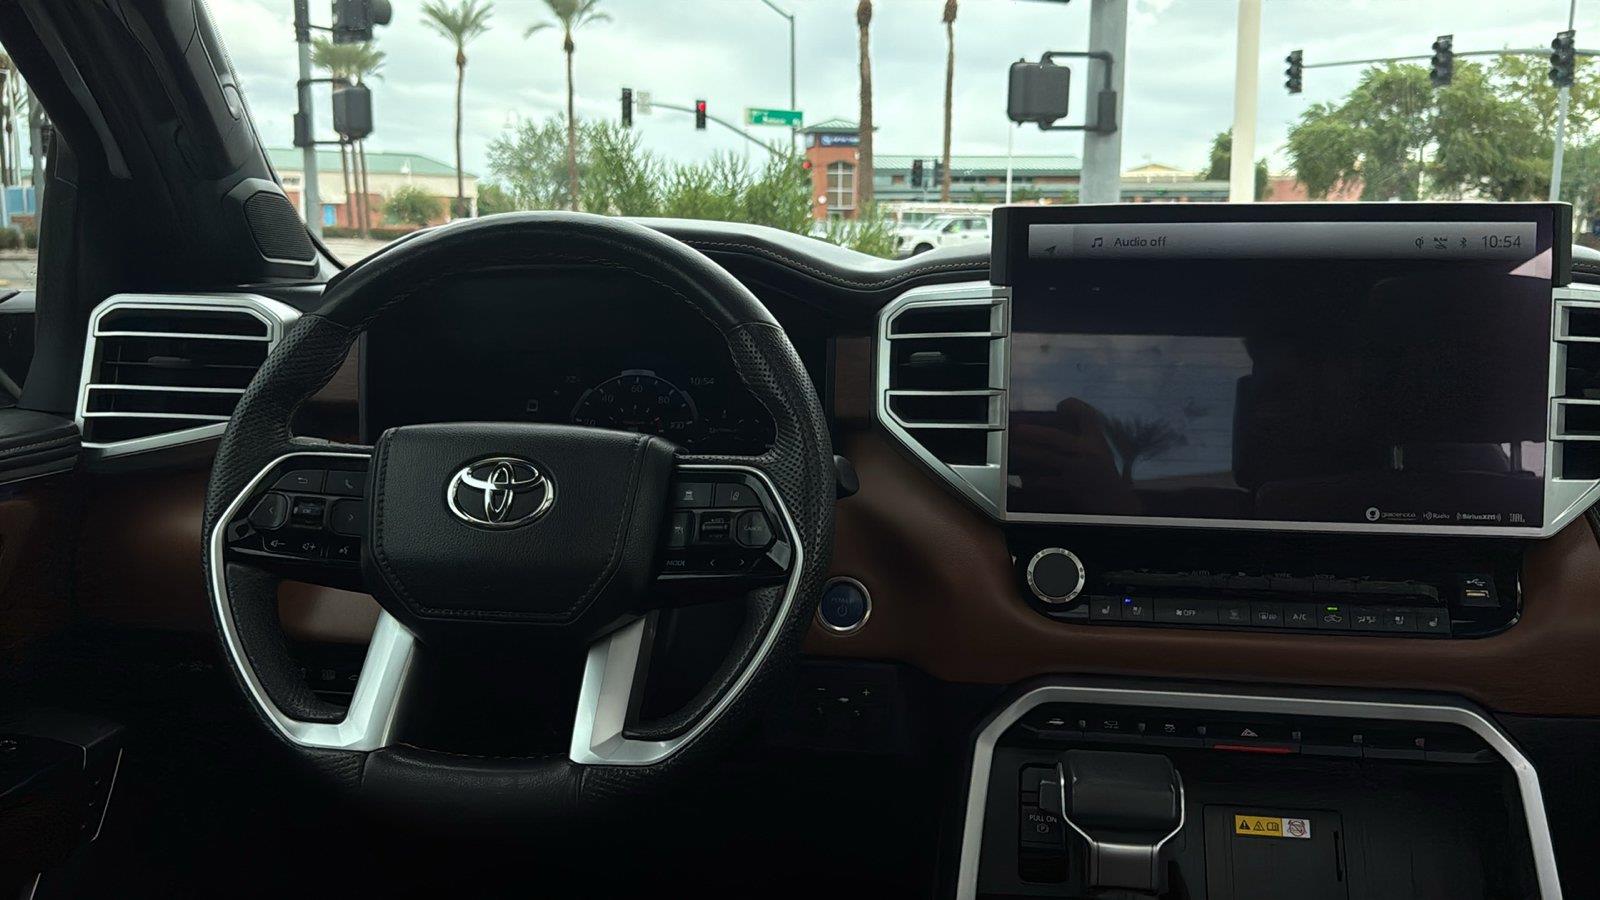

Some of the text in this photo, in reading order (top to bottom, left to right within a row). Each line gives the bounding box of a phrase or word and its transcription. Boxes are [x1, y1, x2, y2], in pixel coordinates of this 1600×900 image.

[1114, 236, 1167, 247] Audio off
[1481, 235, 1521, 248] 10:54
[657, 396, 670, 404] 80
[1046, 815, 1057, 823] ON
